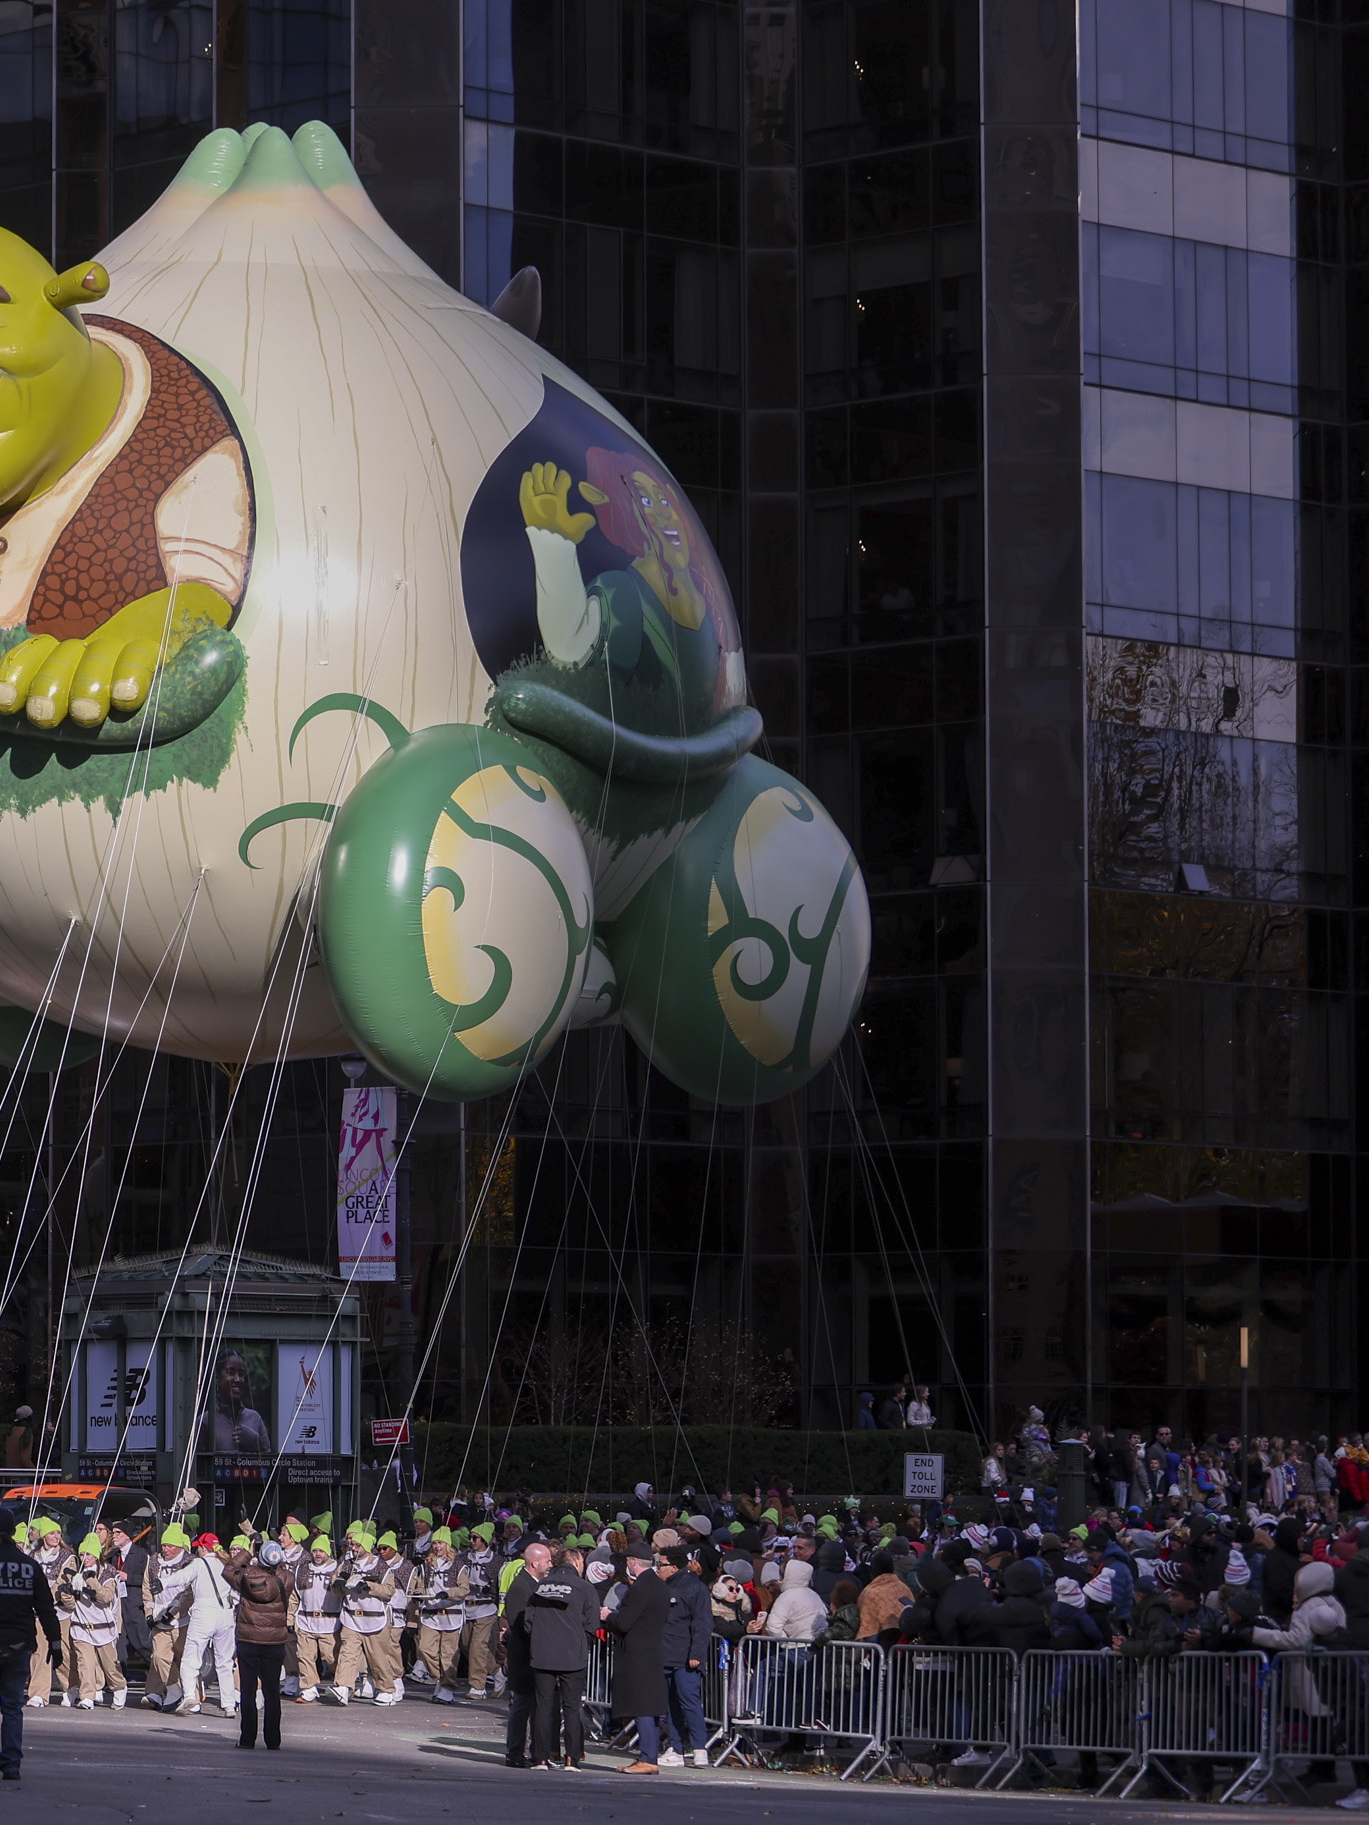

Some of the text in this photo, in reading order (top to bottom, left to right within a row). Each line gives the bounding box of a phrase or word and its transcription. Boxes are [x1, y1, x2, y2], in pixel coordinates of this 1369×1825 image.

[369, 1180, 379, 1194] A
[345, 1196, 391, 1210] GREAT
[346, 1210, 390, 1224] PLACE
[90, 1413, 157, 1427] new lance
[914, 1459, 934, 1467] END
[288, 1476, 313, 1484] Uptown
[912, 1472, 936, 1480] TOLL
[911, 1485, 936, 1494] ZONE
[537, 1584, 572, 1594] NYC
